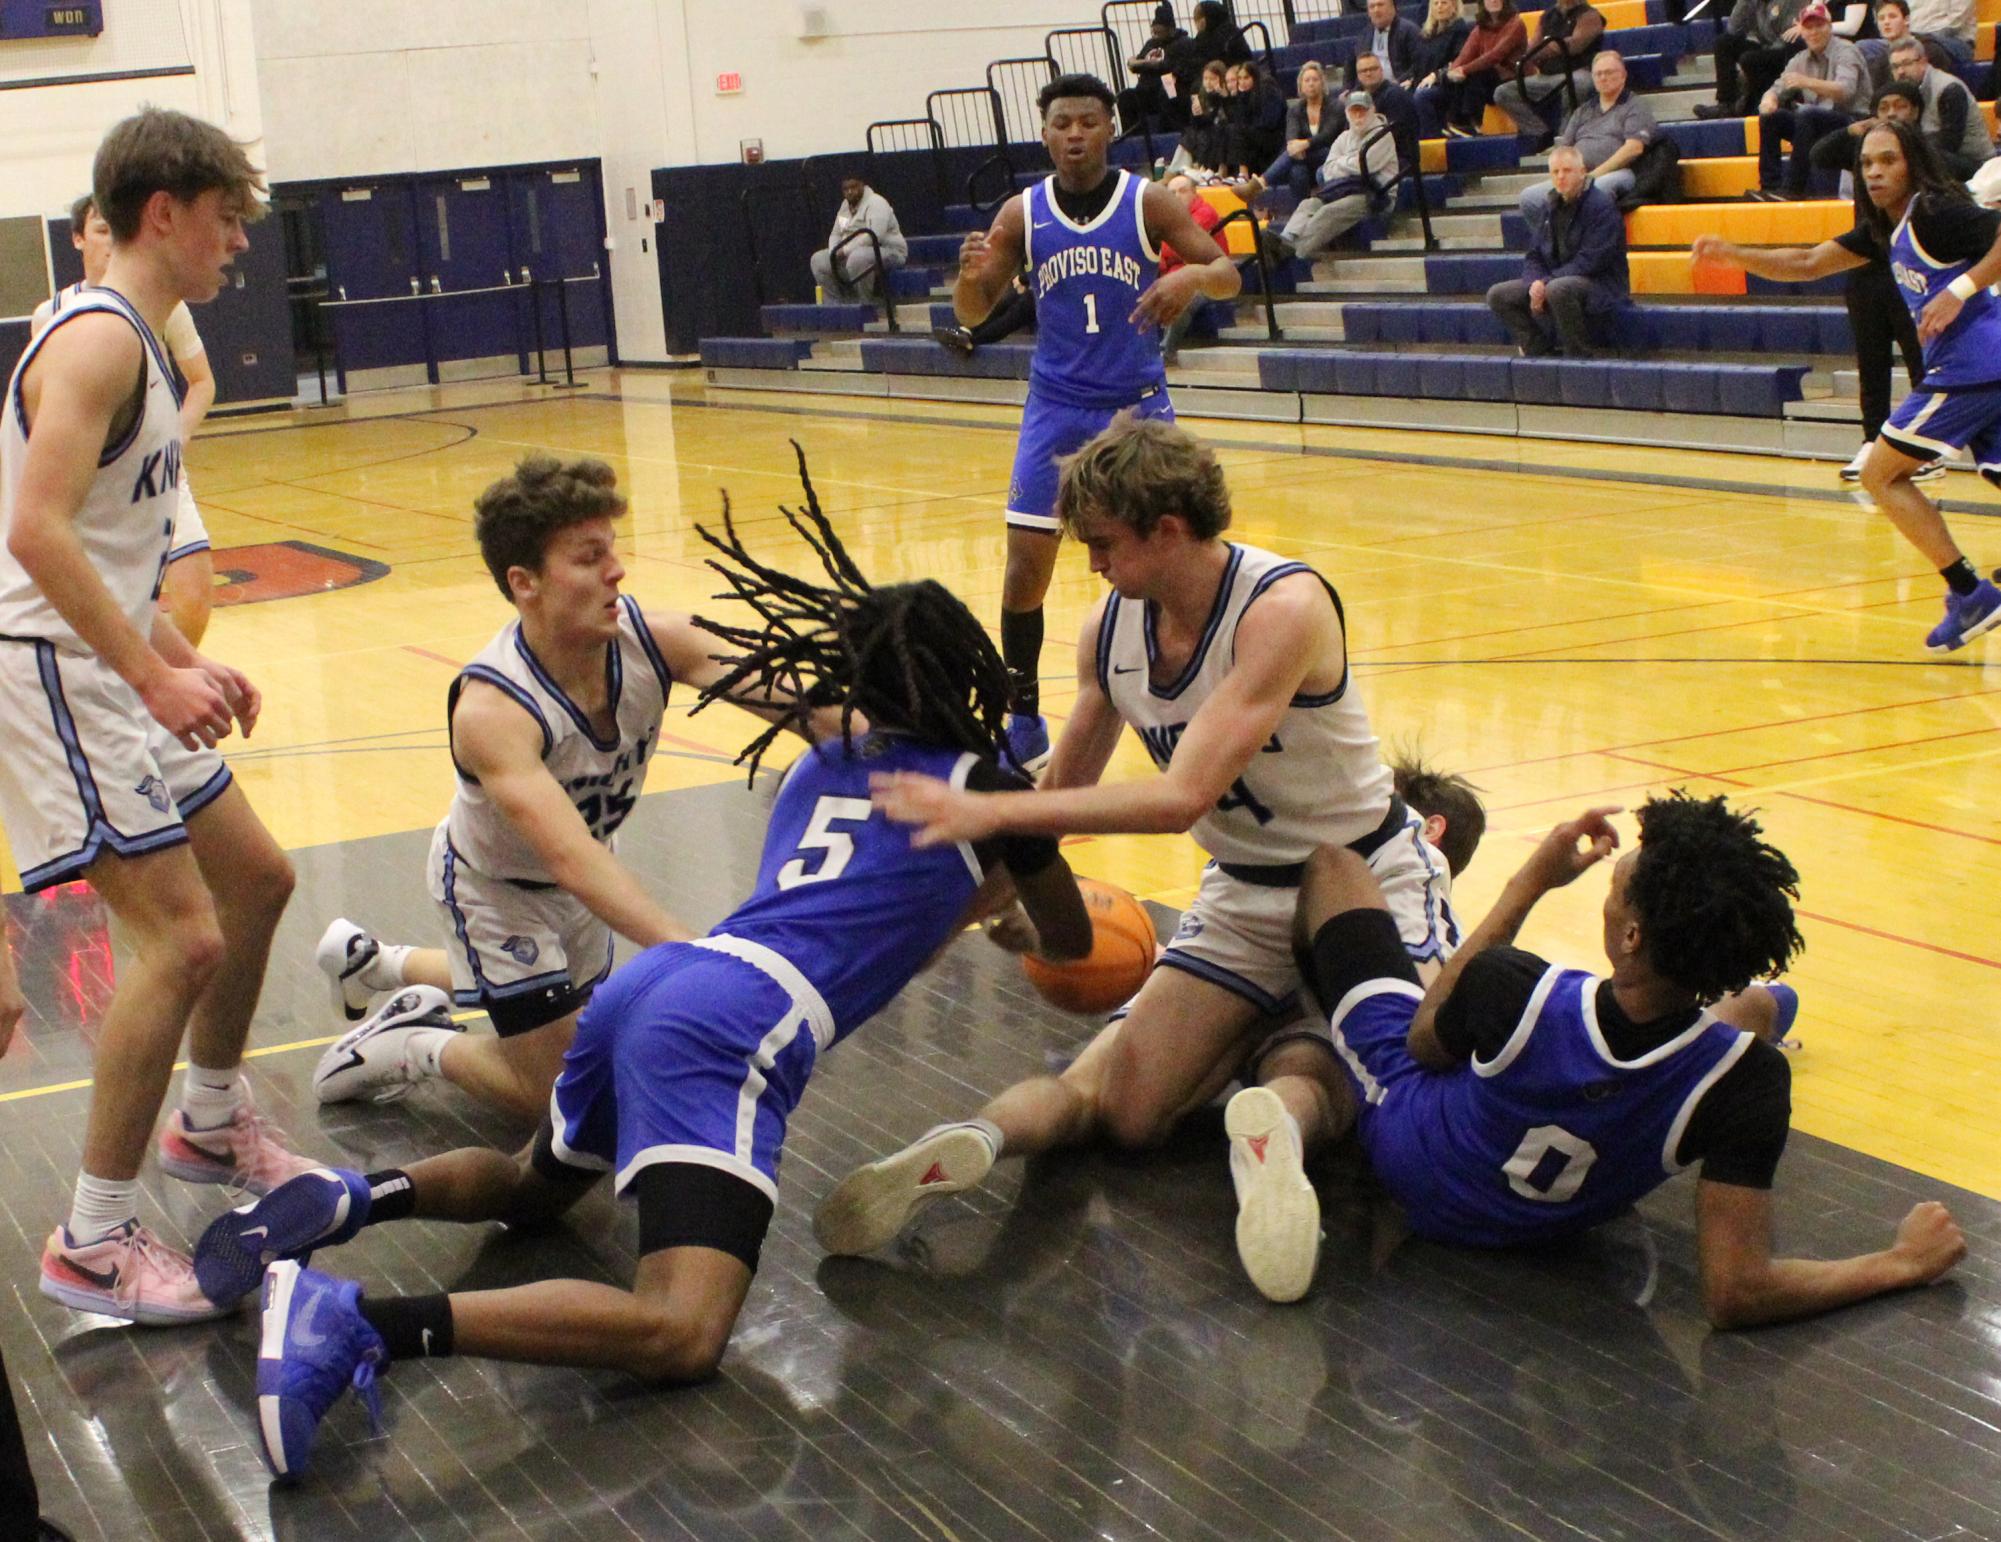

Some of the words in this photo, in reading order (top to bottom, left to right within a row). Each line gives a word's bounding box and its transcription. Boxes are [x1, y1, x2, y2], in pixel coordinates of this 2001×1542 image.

[1038, 246, 1099, 300] PROVISO
[1100, 247, 1141, 291] EAST
[1083, 293, 1100, 334] 1
[776, 795, 873, 892] 5
[1500, 1124, 1598, 1203] 0
